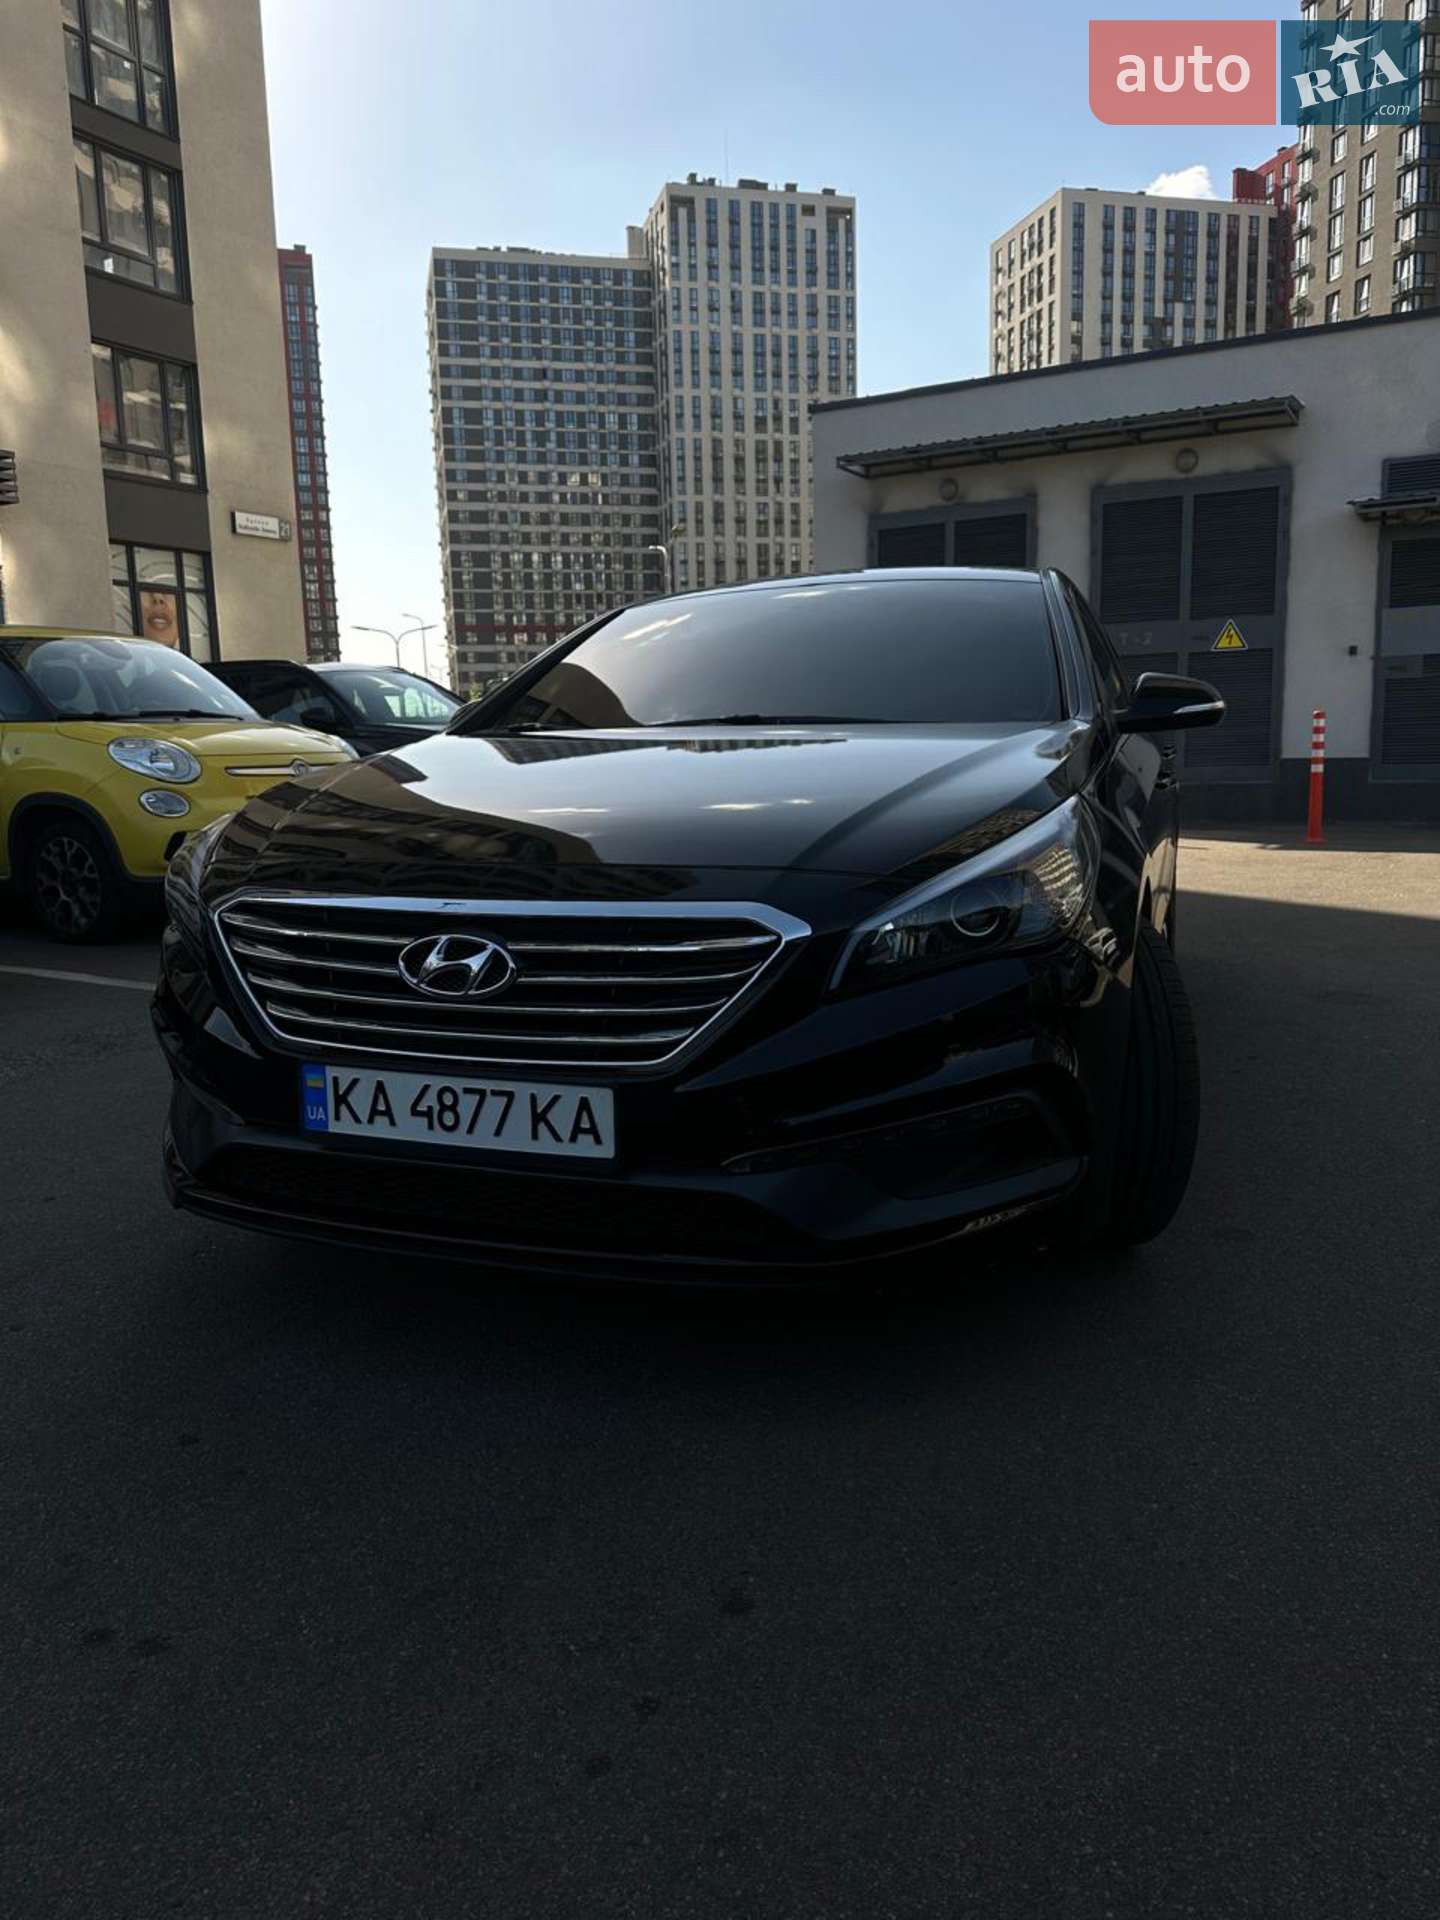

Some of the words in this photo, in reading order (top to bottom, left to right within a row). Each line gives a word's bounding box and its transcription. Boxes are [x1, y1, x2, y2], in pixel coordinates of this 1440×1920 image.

[307, 1105, 326, 1121] UA
[332, 1076, 397, 1127] KA
[410, 1084, 515, 1137] 4877
[529, 1092, 603, 1145] KA
